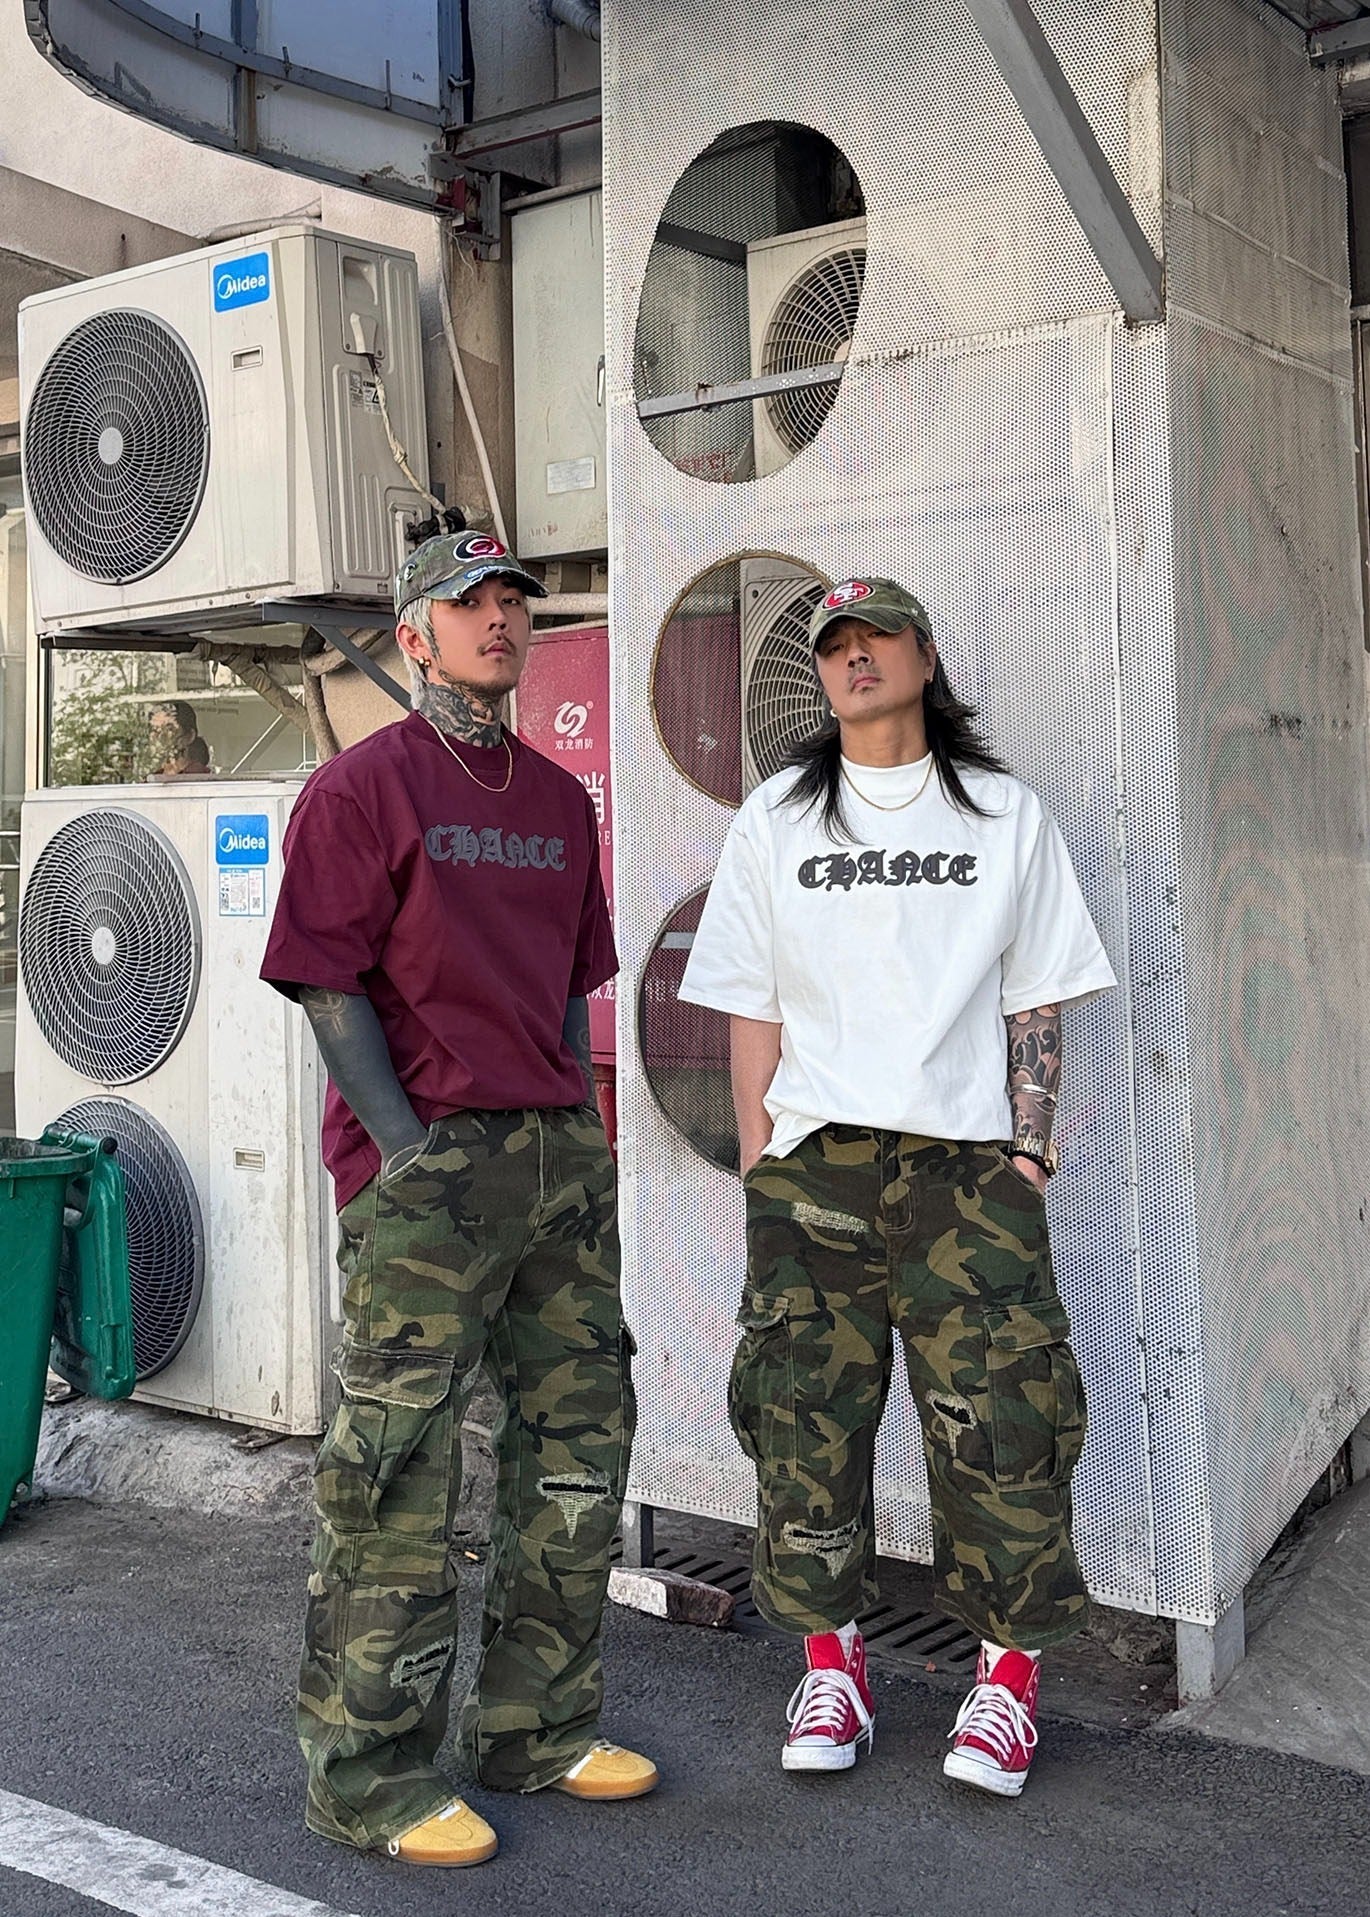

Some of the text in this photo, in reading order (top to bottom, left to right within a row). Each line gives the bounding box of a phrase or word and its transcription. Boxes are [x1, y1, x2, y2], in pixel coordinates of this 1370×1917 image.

[217, 274, 266, 299] Midea
[555, 738, 594, 750] 双龙消防
[219, 827, 266, 853] Midea
[424, 824, 567, 872] CHANCE
[798, 849, 978, 892] CHANCE
